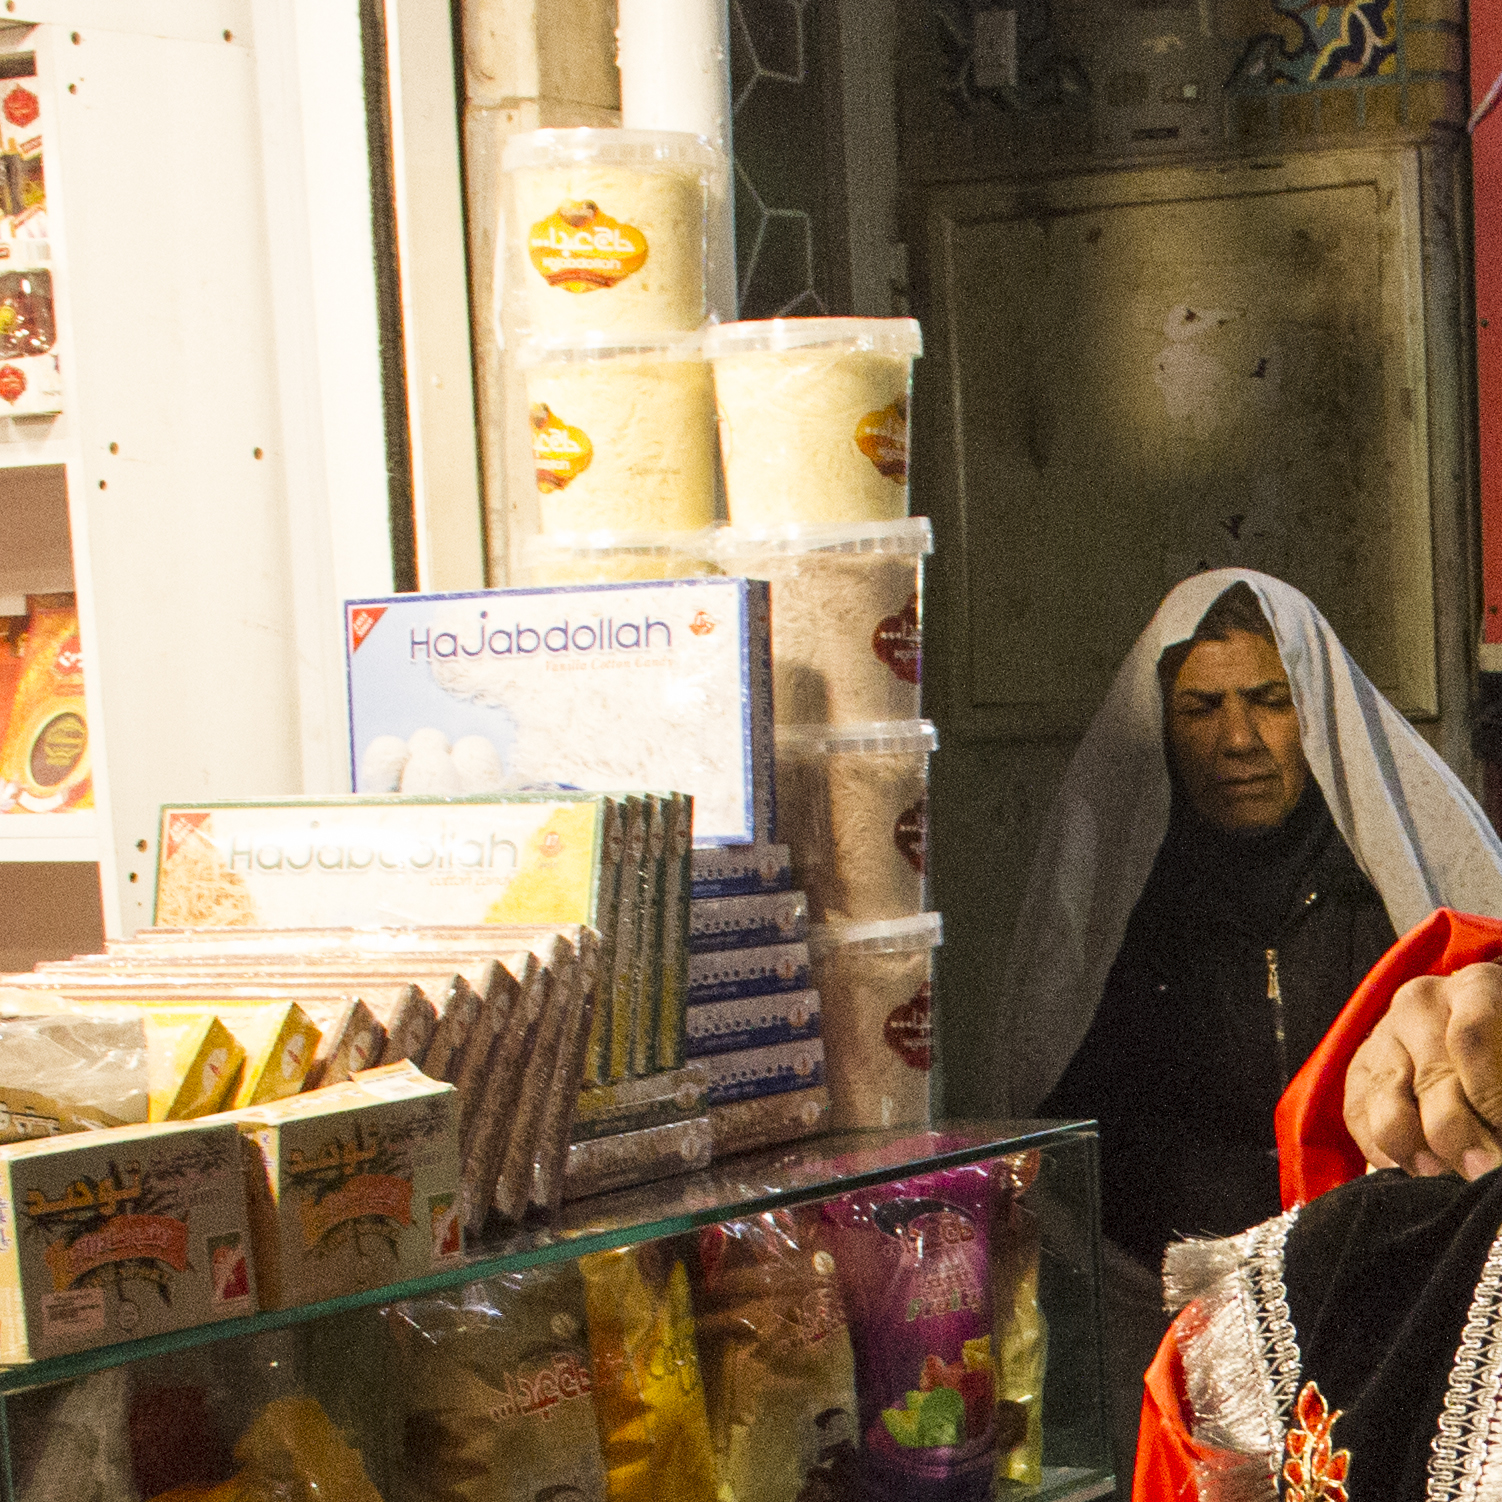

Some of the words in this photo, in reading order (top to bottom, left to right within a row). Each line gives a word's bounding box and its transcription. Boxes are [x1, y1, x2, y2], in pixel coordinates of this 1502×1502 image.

[593, 226, 636, 252] حاج
[410, 611, 672, 663] Hajabdollah
[591, 657, 631, 671] Cotton
[634, 655, 675, 670] Candy
